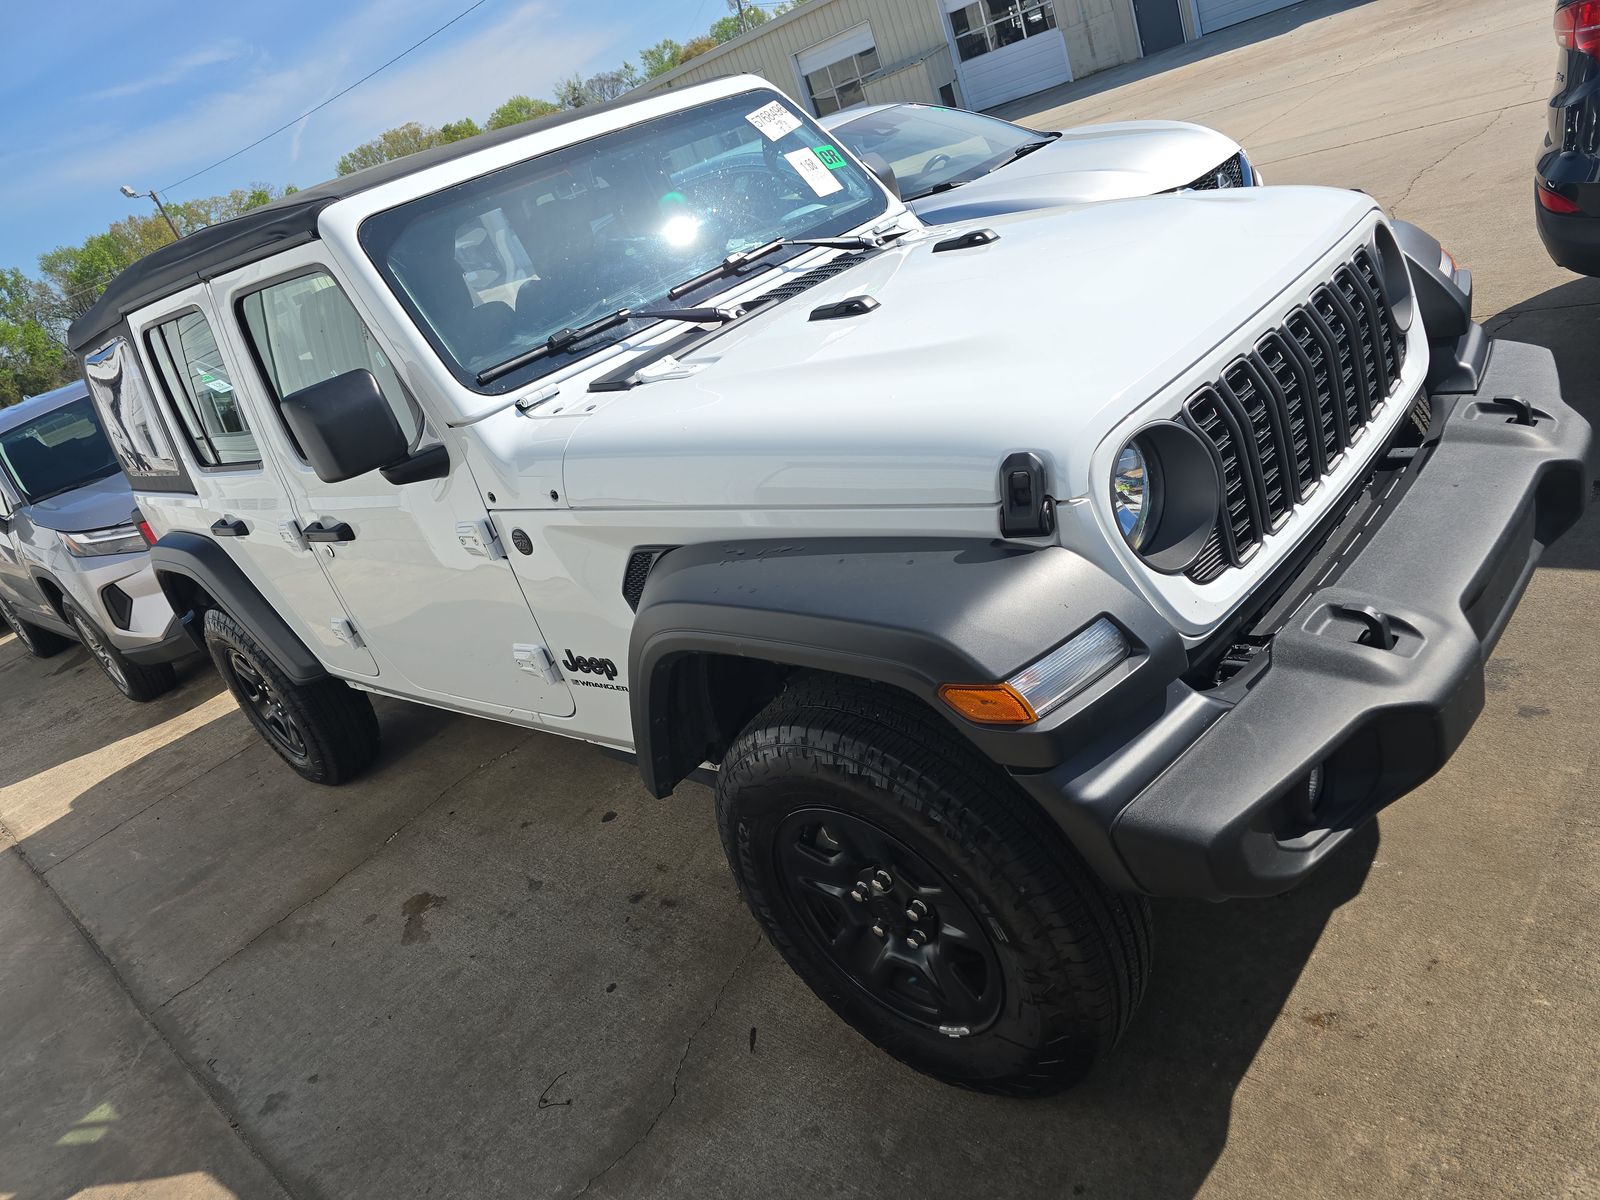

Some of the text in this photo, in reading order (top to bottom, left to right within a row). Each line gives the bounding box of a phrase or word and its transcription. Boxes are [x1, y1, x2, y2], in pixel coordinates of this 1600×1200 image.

[819, 149, 842, 164] CR
[562, 648, 618, 681] Jeep
[578, 679, 630, 693] WRANGLER
